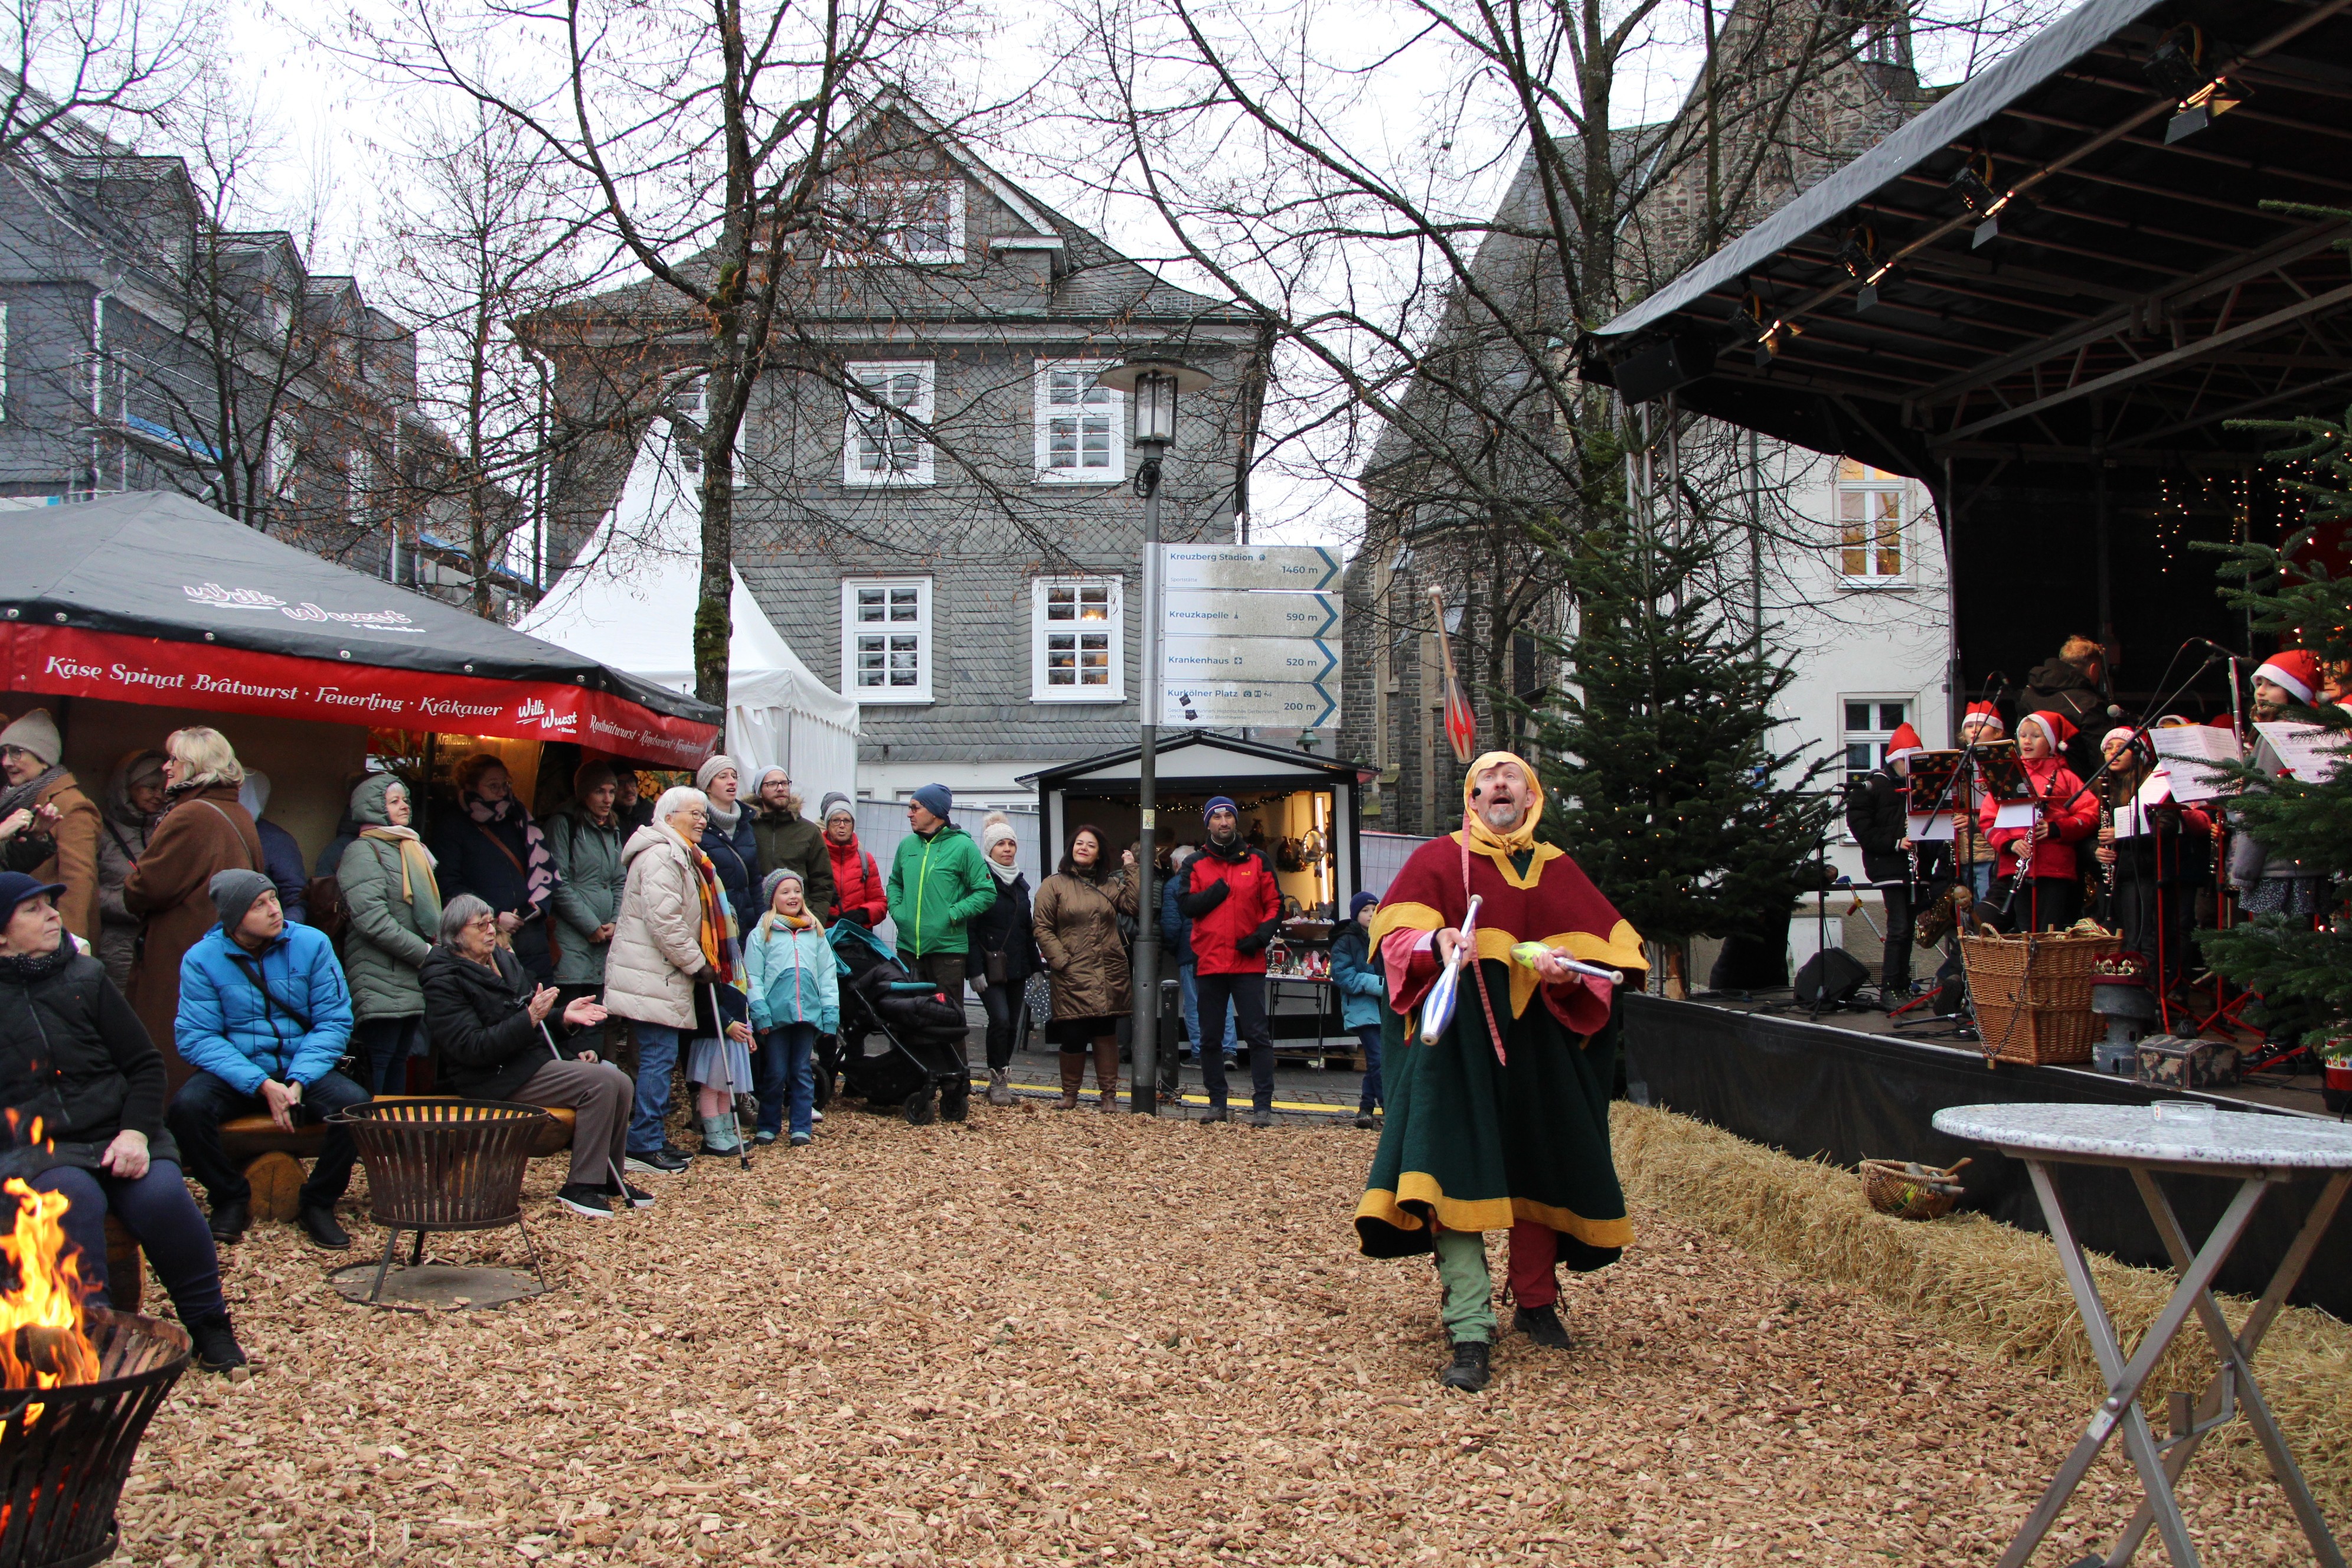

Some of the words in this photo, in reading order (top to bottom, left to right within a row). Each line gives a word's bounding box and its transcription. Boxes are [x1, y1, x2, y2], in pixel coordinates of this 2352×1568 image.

[1170, 553, 1217, 561] Kreuzberg
[1219, 553, 1253, 561] Stadion
[1282, 566, 1305, 574] 1460
[282, 603, 412, 623] Wurst
[1169, 610, 1229, 620] Kreuzkapelle
[1168, 656, 1229, 665] Krankenhaus
[45, 655, 103, 681] Käse
[110, 664, 185, 689] Spinat
[191, 674, 299, 700] Bratwurst
[315, 687, 404, 713] Feuerling
[418, 697, 503, 717] Krakauer
[518, 697, 545, 717] Willi
[1283, 703, 1304, 711] 200
[541, 708, 577, 729] Wurst
[589, 714, 637, 740] Rostbratwurst
[639, 730, 674, 749] Rindswurst
